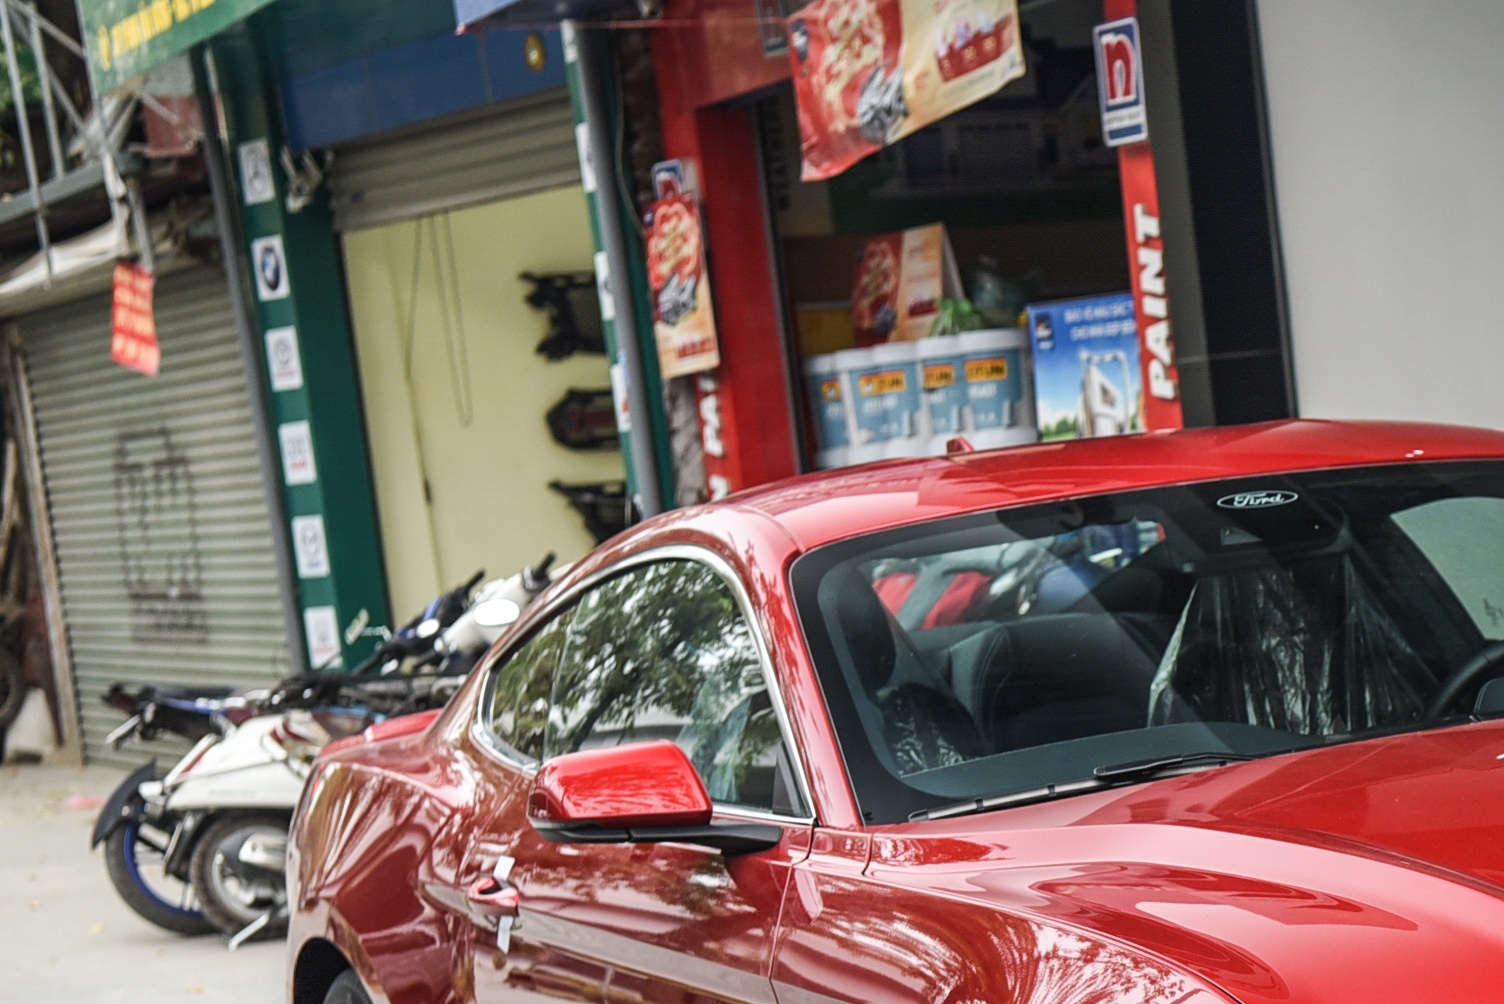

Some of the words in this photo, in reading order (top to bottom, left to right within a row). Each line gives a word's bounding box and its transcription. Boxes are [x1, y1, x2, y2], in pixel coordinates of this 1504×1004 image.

[1133, 203, 1176, 400] PAINT
[698, 377, 724, 458] PAI
[1231, 491, 1286, 508] Ford
